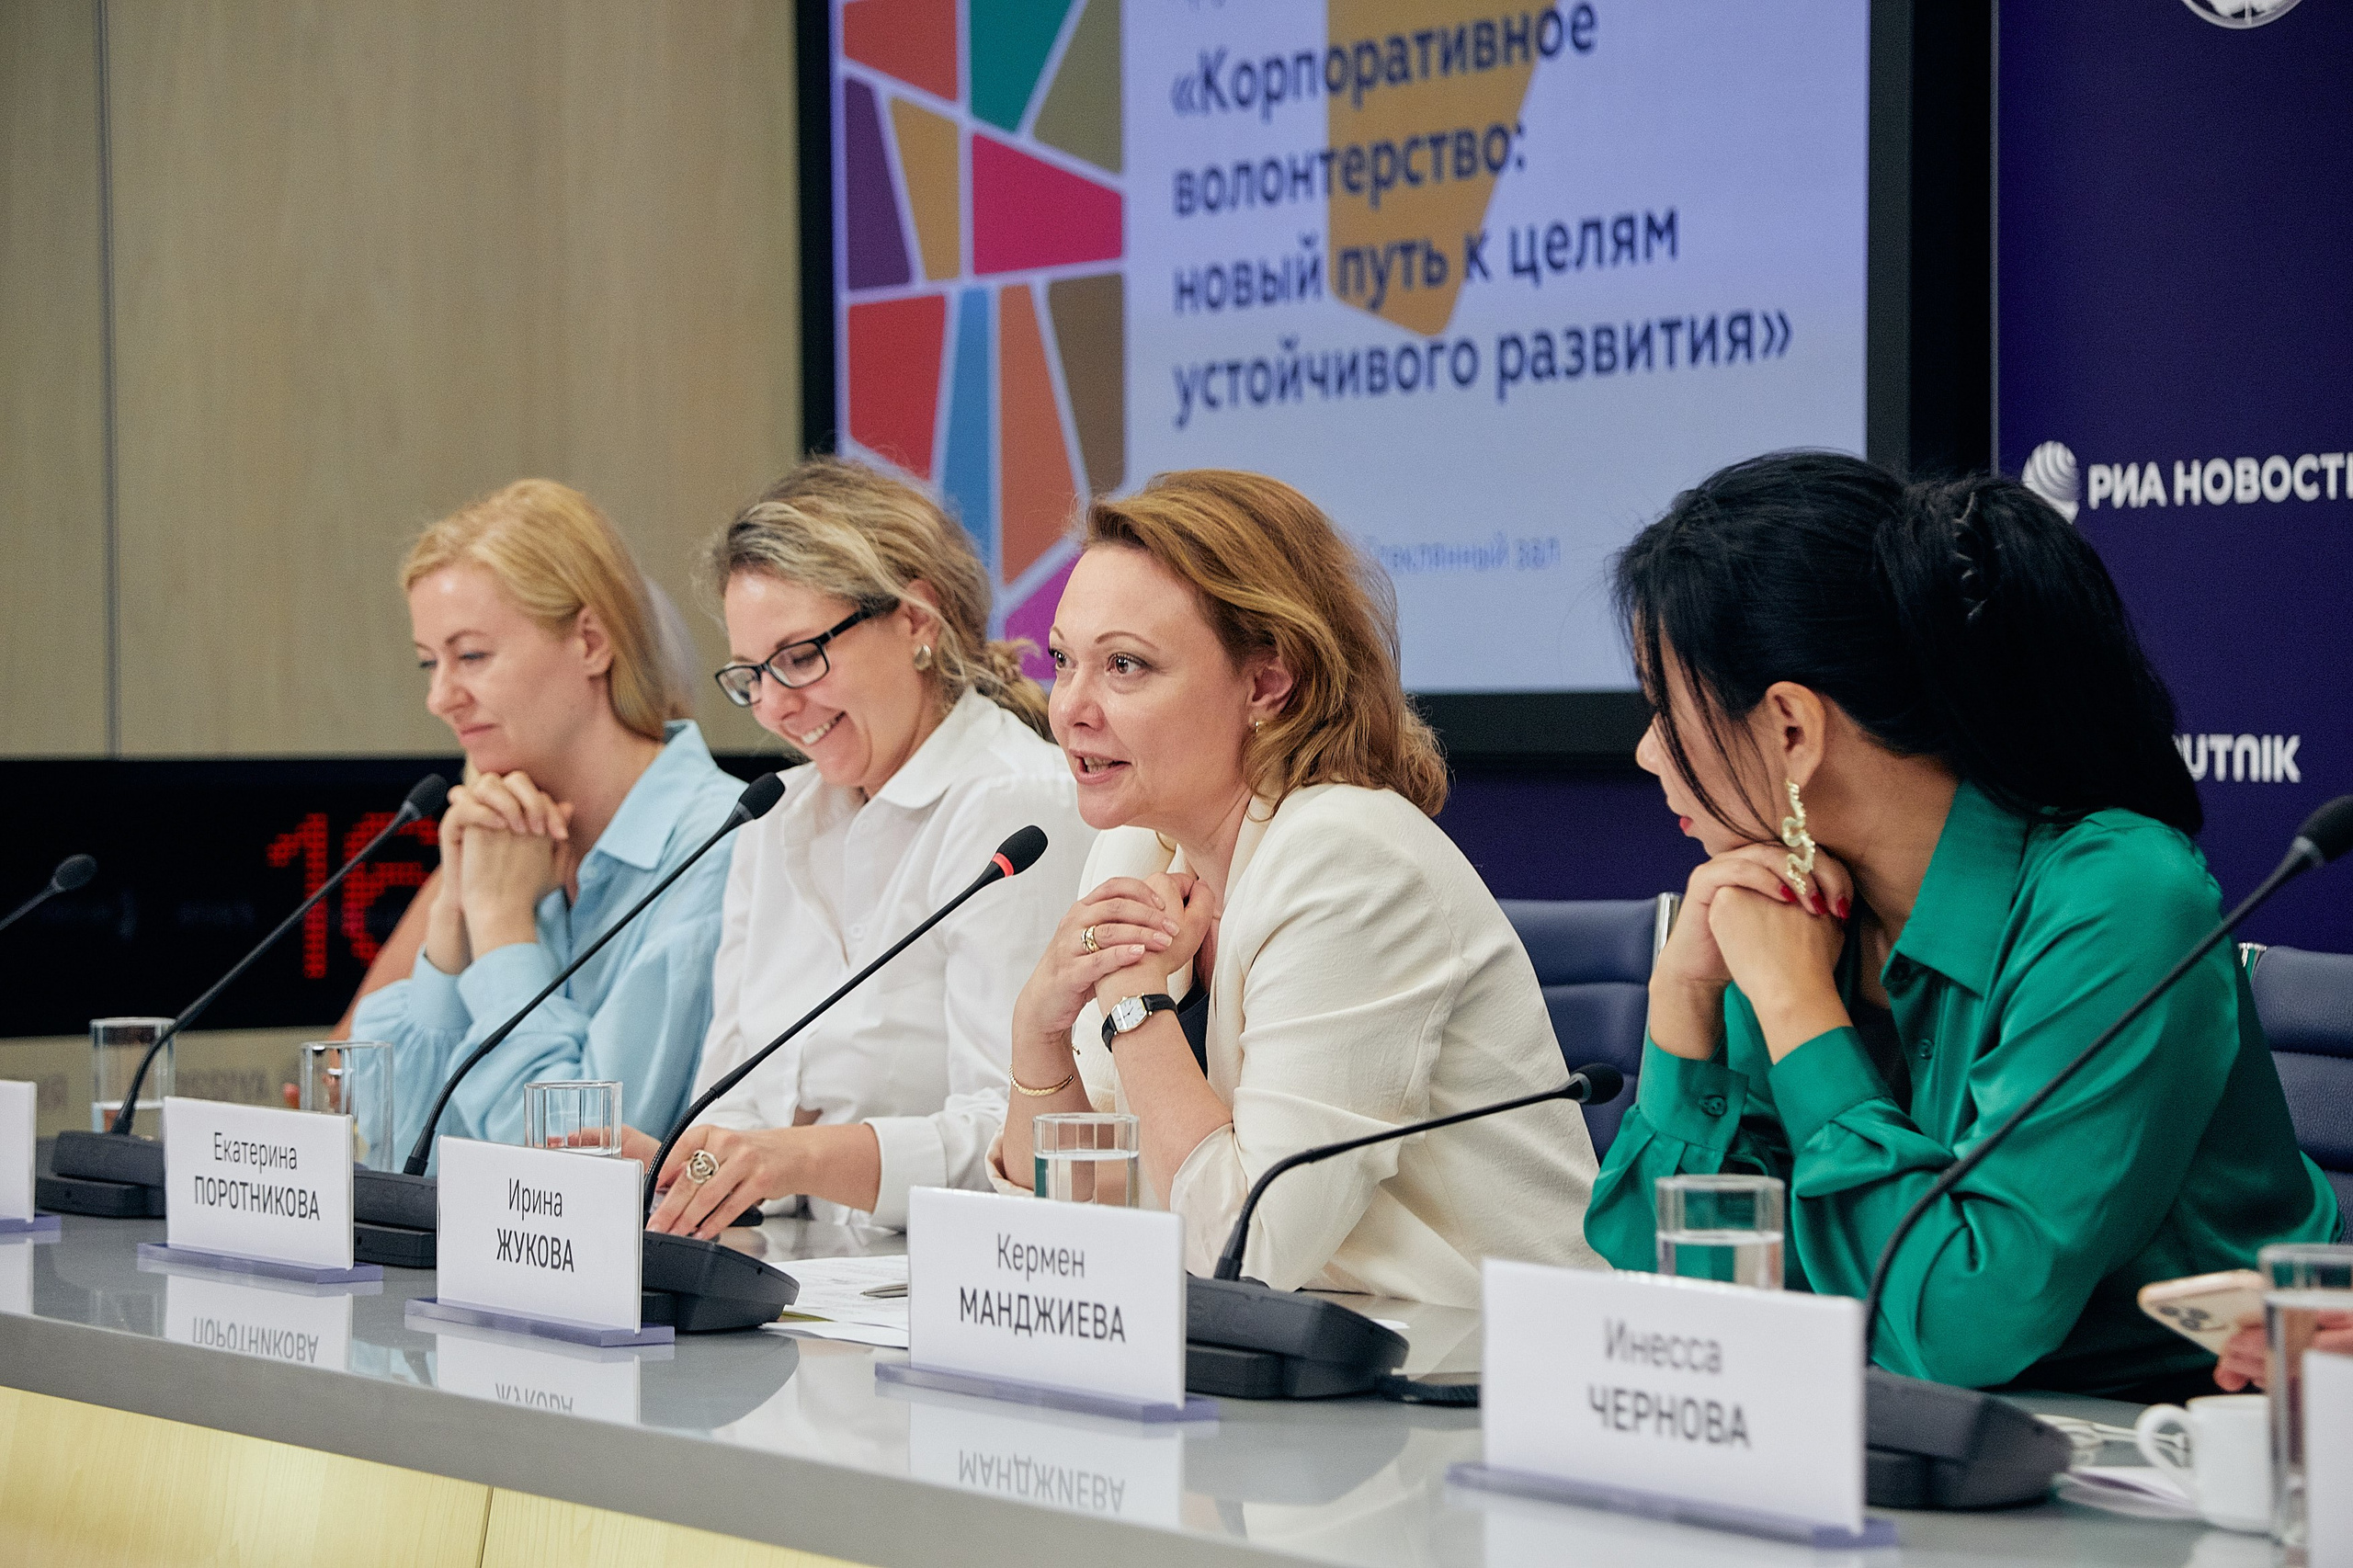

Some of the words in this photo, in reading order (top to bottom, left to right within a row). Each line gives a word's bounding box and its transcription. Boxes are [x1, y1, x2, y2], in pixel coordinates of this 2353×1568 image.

[1171, 3, 1597, 122] «Корпоративное
[1174, 120, 1527, 217] волонтерство:
[1174, 233, 1322, 313] новый
[1336, 236, 1449, 310] путь
[1463, 229, 1491, 282] к
[1508, 207, 1680, 286] целям
[1174, 333, 1480, 429] устойчивого
[1495, 309, 1793, 403] развития»
[2087, 461, 2167, 510] РИА
[2172, 733, 2301, 783] UTNIK
[214, 1131, 298, 1174] Екатерина
[194, 1176, 321, 1221] ПОРОТНИКОВА
[508, 1177, 563, 1221] Ирина
[496, 1228, 574, 1273] ЖУКОВА
[996, 1232, 1086, 1281] Кермен
[960, 1287, 1126, 1343] МАНДЖИЕВА
[1604, 1317, 1722, 1374] Инесса
[1587, 1383, 1751, 1449] ЧЕРНОВА
